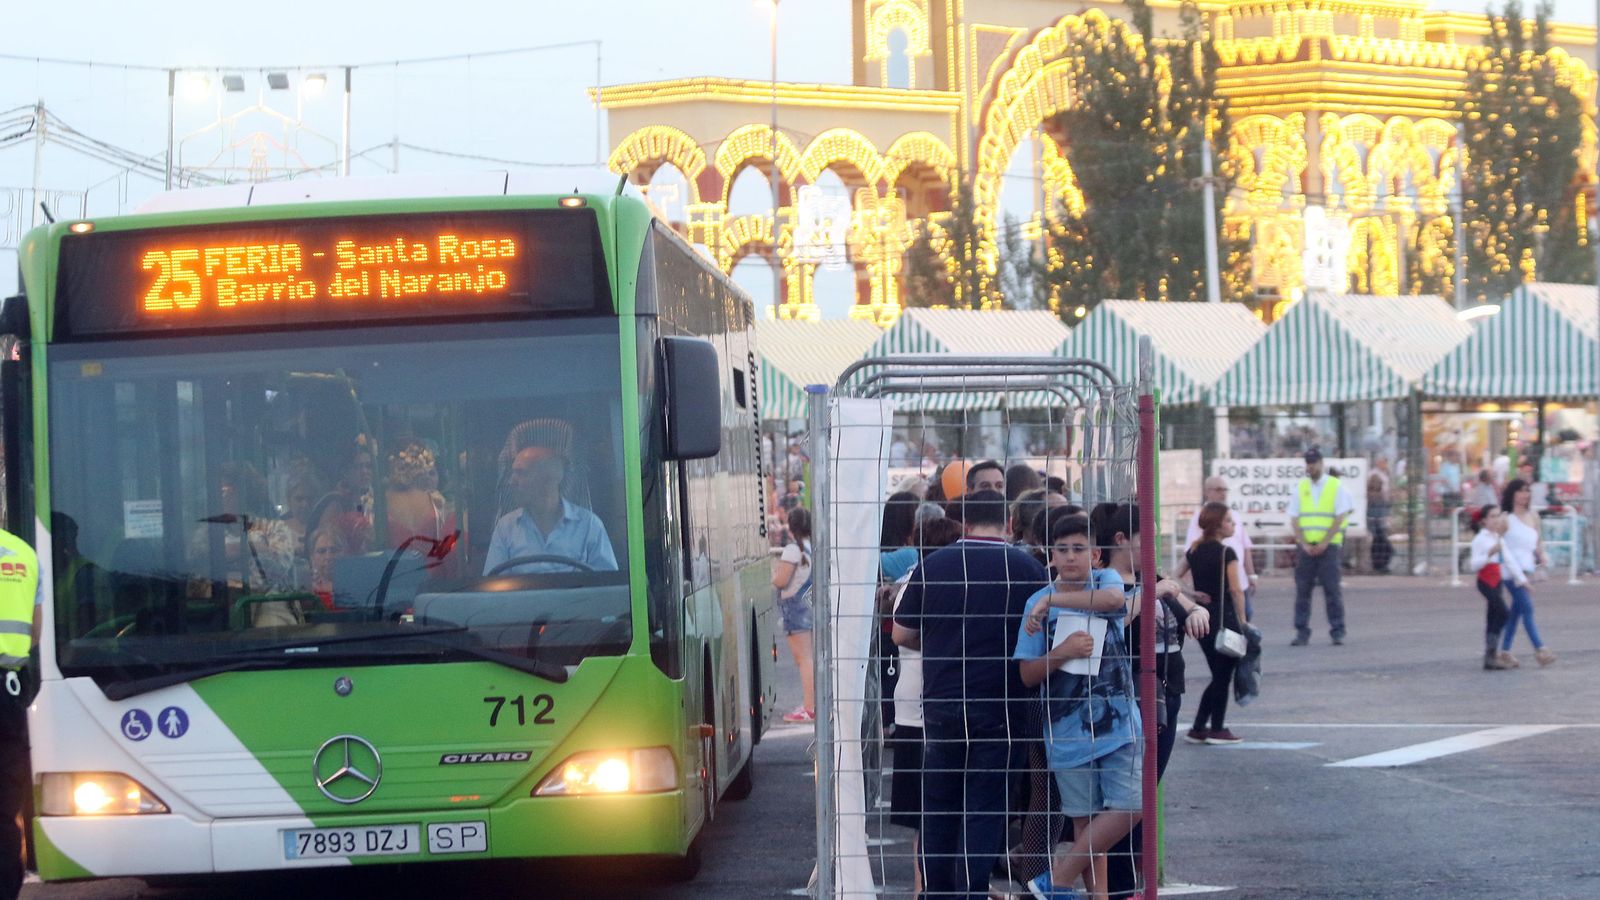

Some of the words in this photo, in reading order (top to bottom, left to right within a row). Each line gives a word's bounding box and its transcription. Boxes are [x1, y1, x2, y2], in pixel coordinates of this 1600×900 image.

[204, 243, 302, 276] FERIA
[336, 238, 428, 269] Santa
[438, 235, 516, 264] Rosa
[142, 249, 201, 311] 25
[216, 275, 317, 307] Barrio
[327, 271, 369, 297] del
[379, 264, 507, 298] Naranjo
[1218, 465, 1249, 479] POR
[1253, 465, 1272, 479] SU
[1240, 483, 1298, 497] CIRCUL
[483, 693, 556, 728] 712
[443, 752, 528, 764] CITARO
[299, 831, 356, 856] 7893
[365, 828, 409, 852] DZJ
